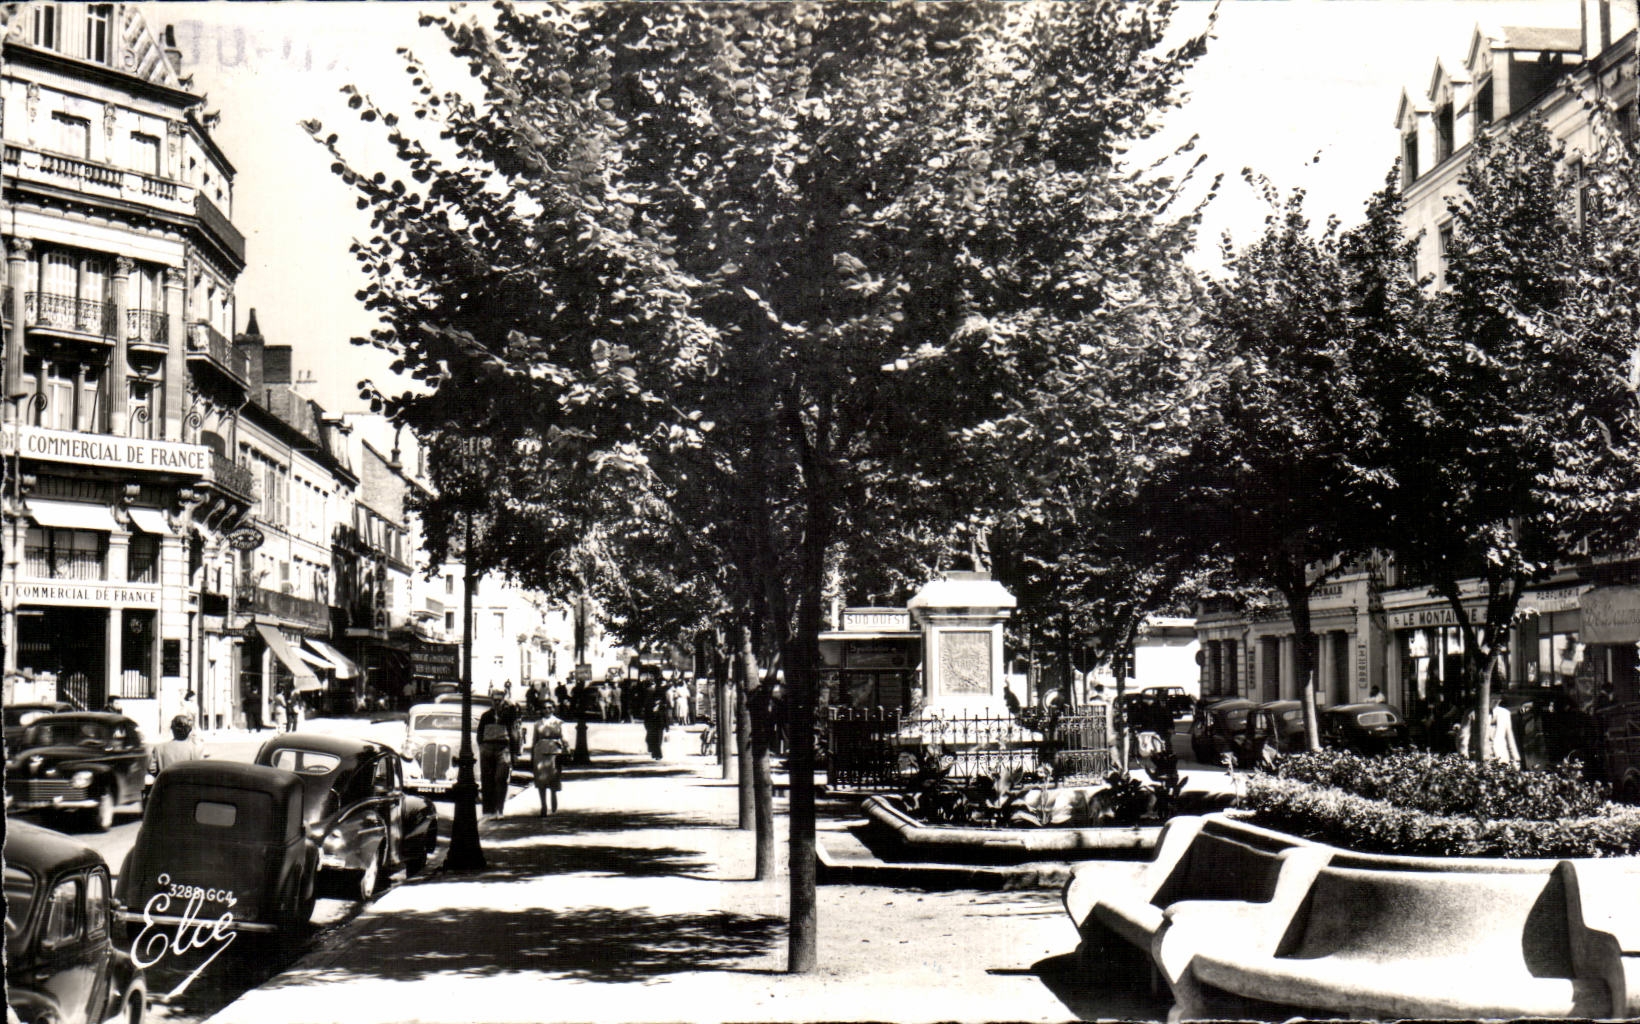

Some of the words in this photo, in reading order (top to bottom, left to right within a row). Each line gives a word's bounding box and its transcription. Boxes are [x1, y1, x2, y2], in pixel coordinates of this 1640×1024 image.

[28, 434, 121, 461] COMMERCIAL
[127, 446, 144, 464] DE
[151, 447, 205, 469] FRANCE
[16, 586, 89, 600] COMMERCIAL
[96, 588, 109, 600] DE
[114, 589, 156, 602] FRANCE
[1403, 612, 1414, 626] LE
[1420, 608, 1478, 624] MONTAIE
